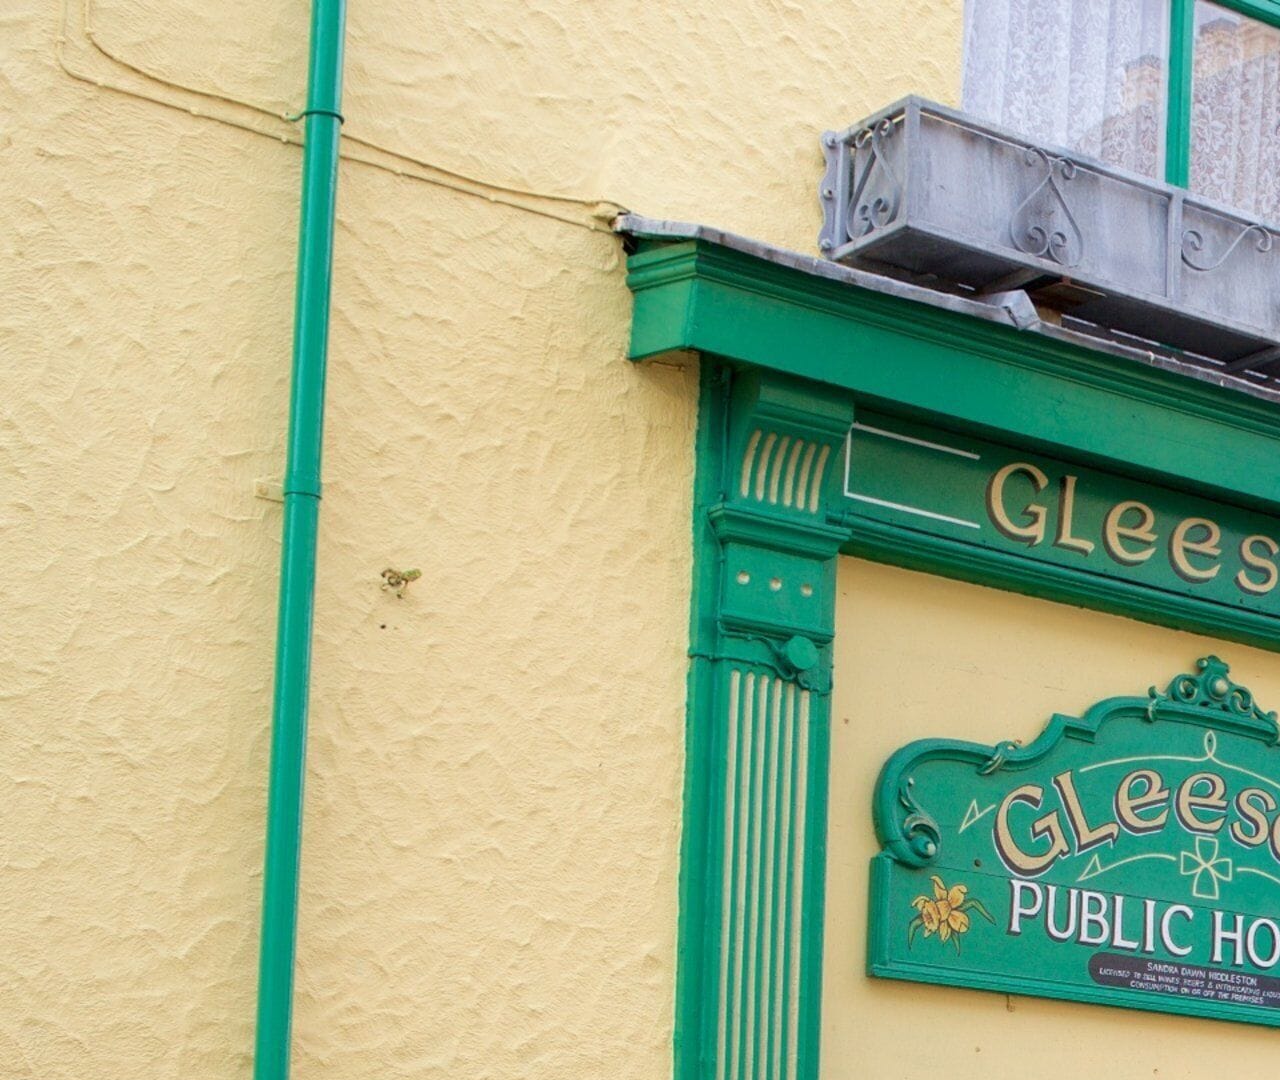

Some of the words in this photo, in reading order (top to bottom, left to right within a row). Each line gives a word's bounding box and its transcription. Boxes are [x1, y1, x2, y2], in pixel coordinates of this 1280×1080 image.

[1006, 879, 1195, 956] PUBLIC
[1147, 962, 1179, 974] SANDRA
[1181, 967, 1206, 979] DAWN
